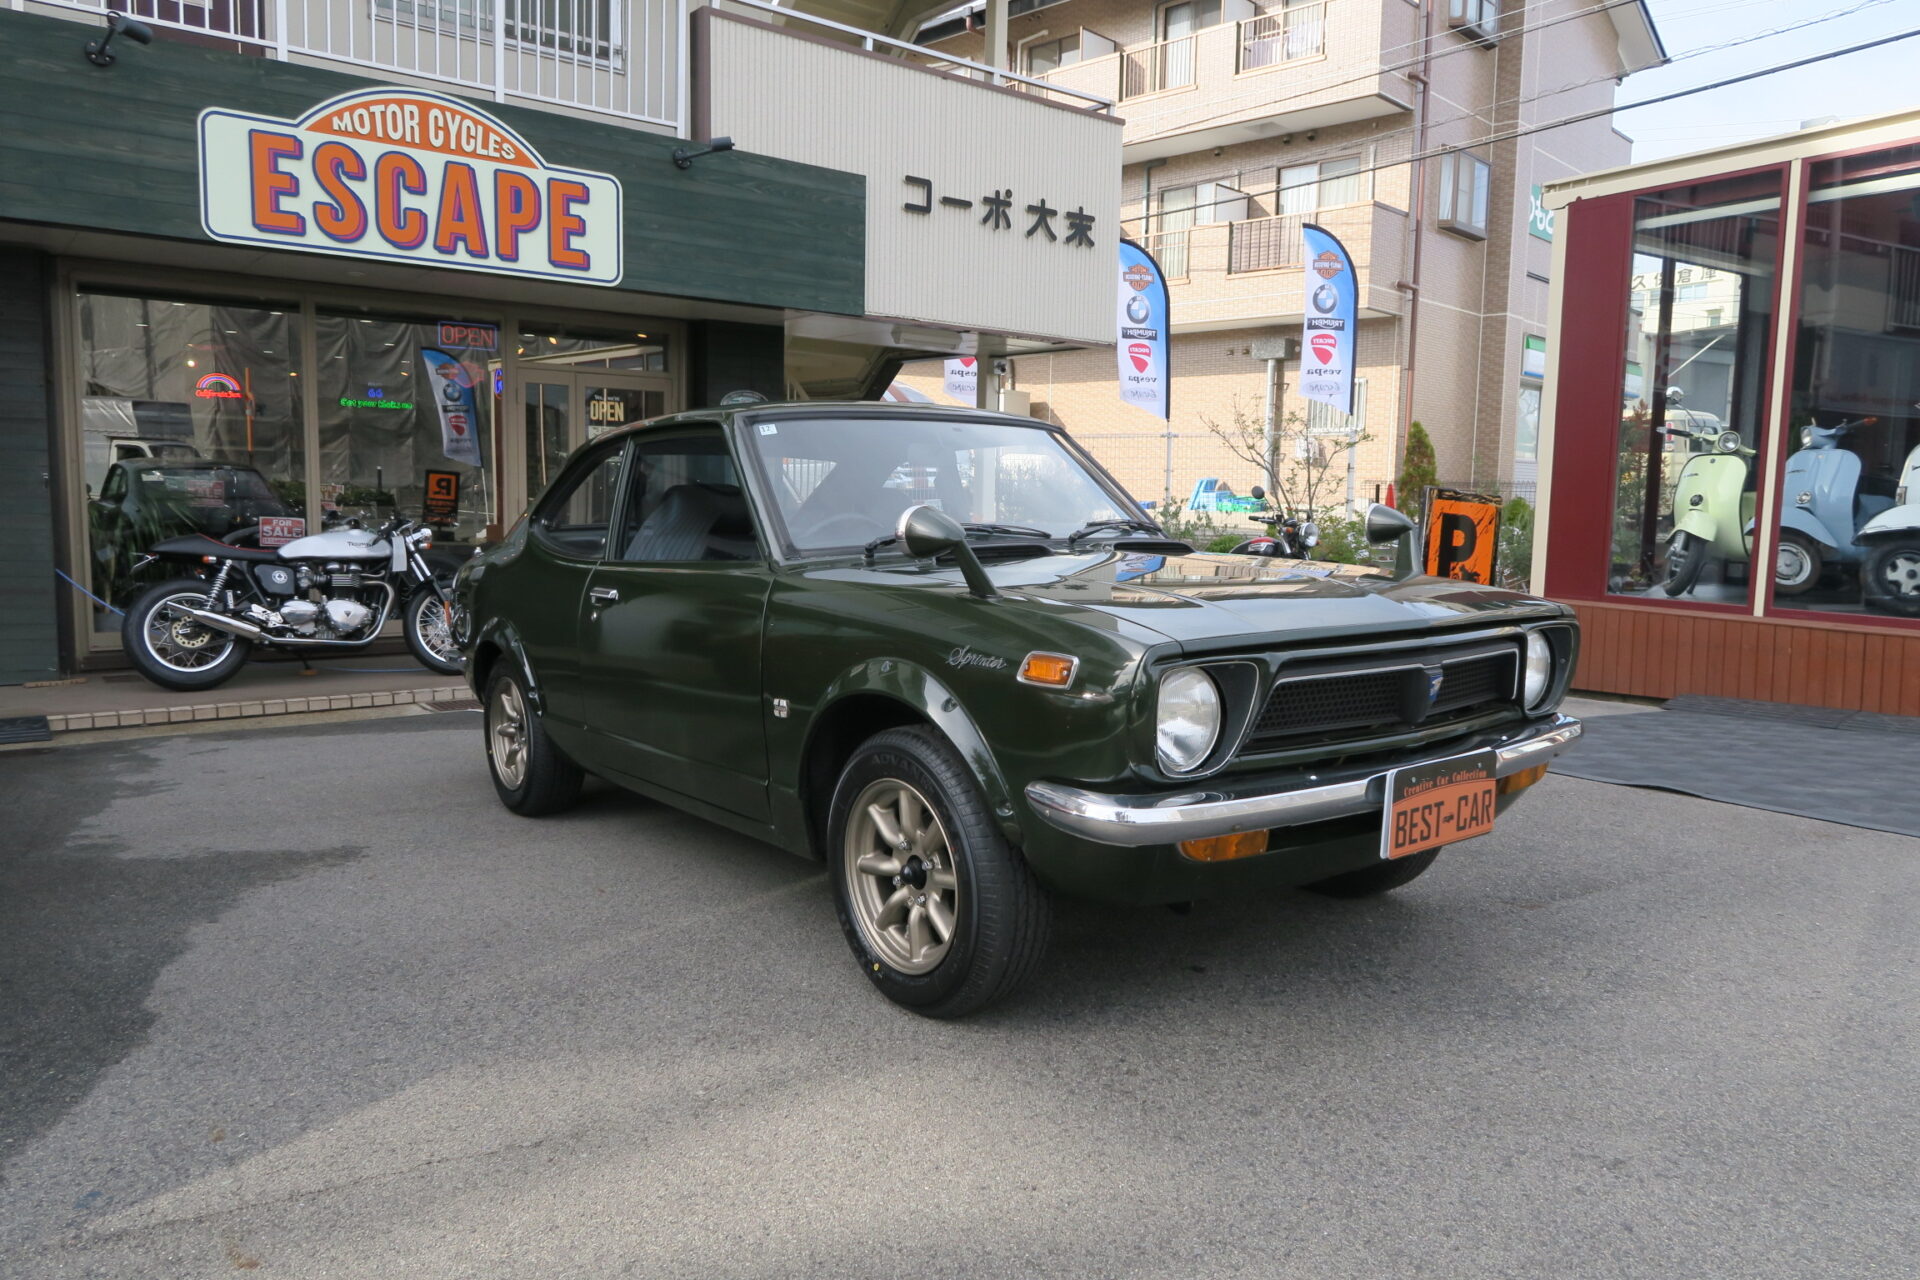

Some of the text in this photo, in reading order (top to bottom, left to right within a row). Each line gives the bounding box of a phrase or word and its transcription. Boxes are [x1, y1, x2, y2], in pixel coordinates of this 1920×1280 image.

[333, 104, 516, 160] MOTOR CYCLES
[248, 128, 591, 272] ESCAPE
[904, 174, 1096, 248] コーポ大末
[441, 325, 494, 346] OPEN
[590, 400, 625, 422] OPEN
[262, 526, 303, 538] SALE
[272, 519, 293, 527] FOR
[1437, 512, 1477, 578] P
[945, 645, 1007, 669] Sprinter
[1403, 769, 1487, 797] Creative Car Collection
